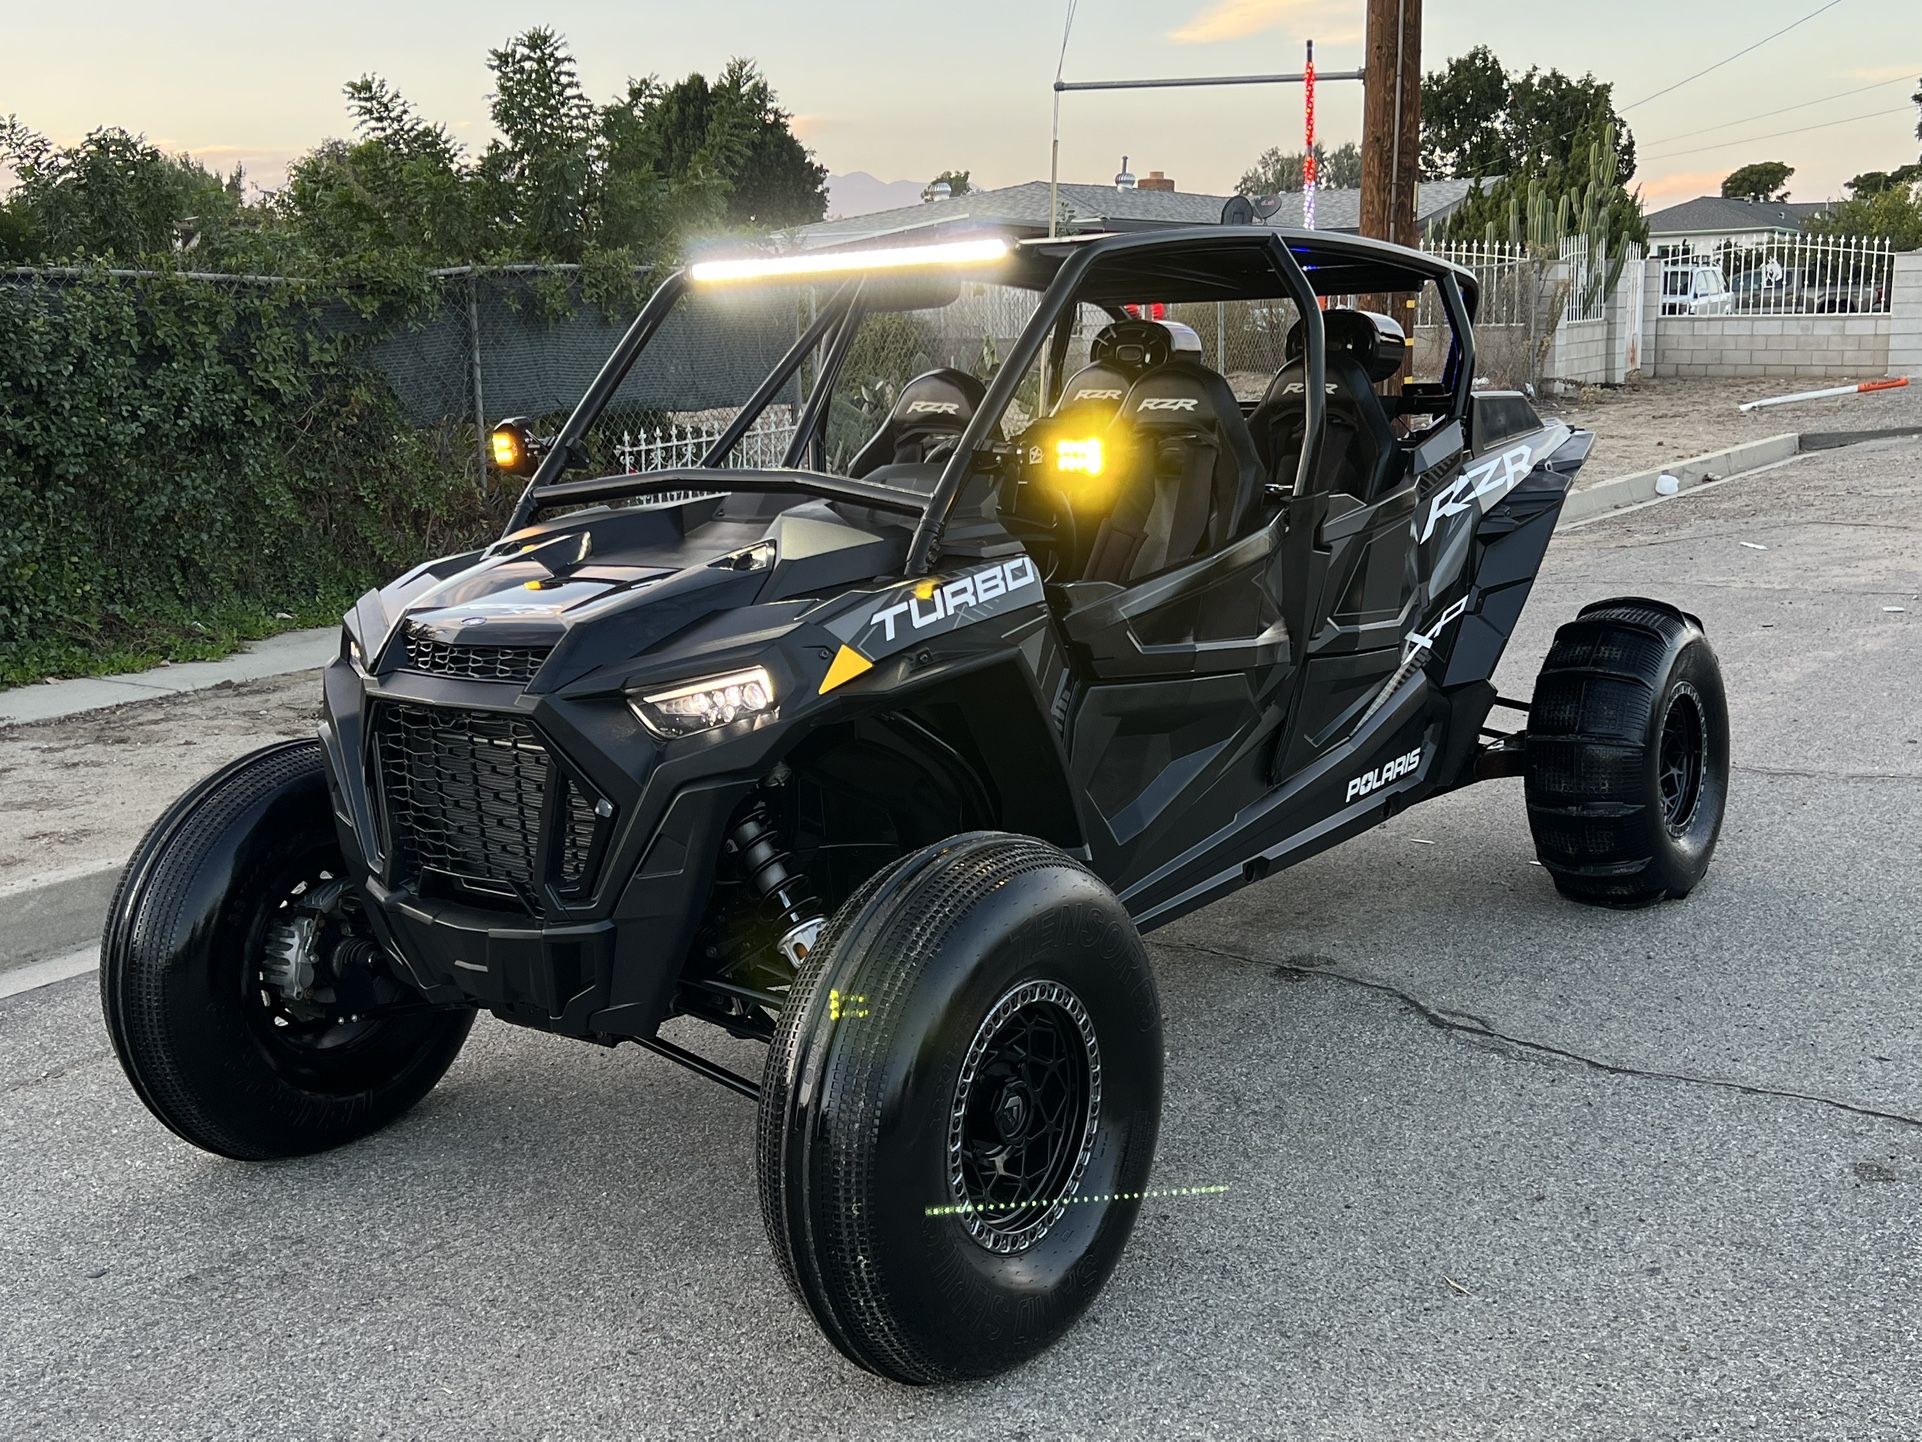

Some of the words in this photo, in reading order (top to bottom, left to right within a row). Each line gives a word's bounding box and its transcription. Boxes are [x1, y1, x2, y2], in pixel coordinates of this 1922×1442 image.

[1073, 389, 1122, 401] RZR
[1136, 398, 1199, 412] RZR
[1281, 382, 1339, 395] RR
[906, 401, 960, 415] RZR
[1420, 445, 1532, 544] RZR
[870, 555, 1036, 642] TURBO
[1402, 594, 1469, 665] XP
[1346, 748, 1421, 803] POLARIS
